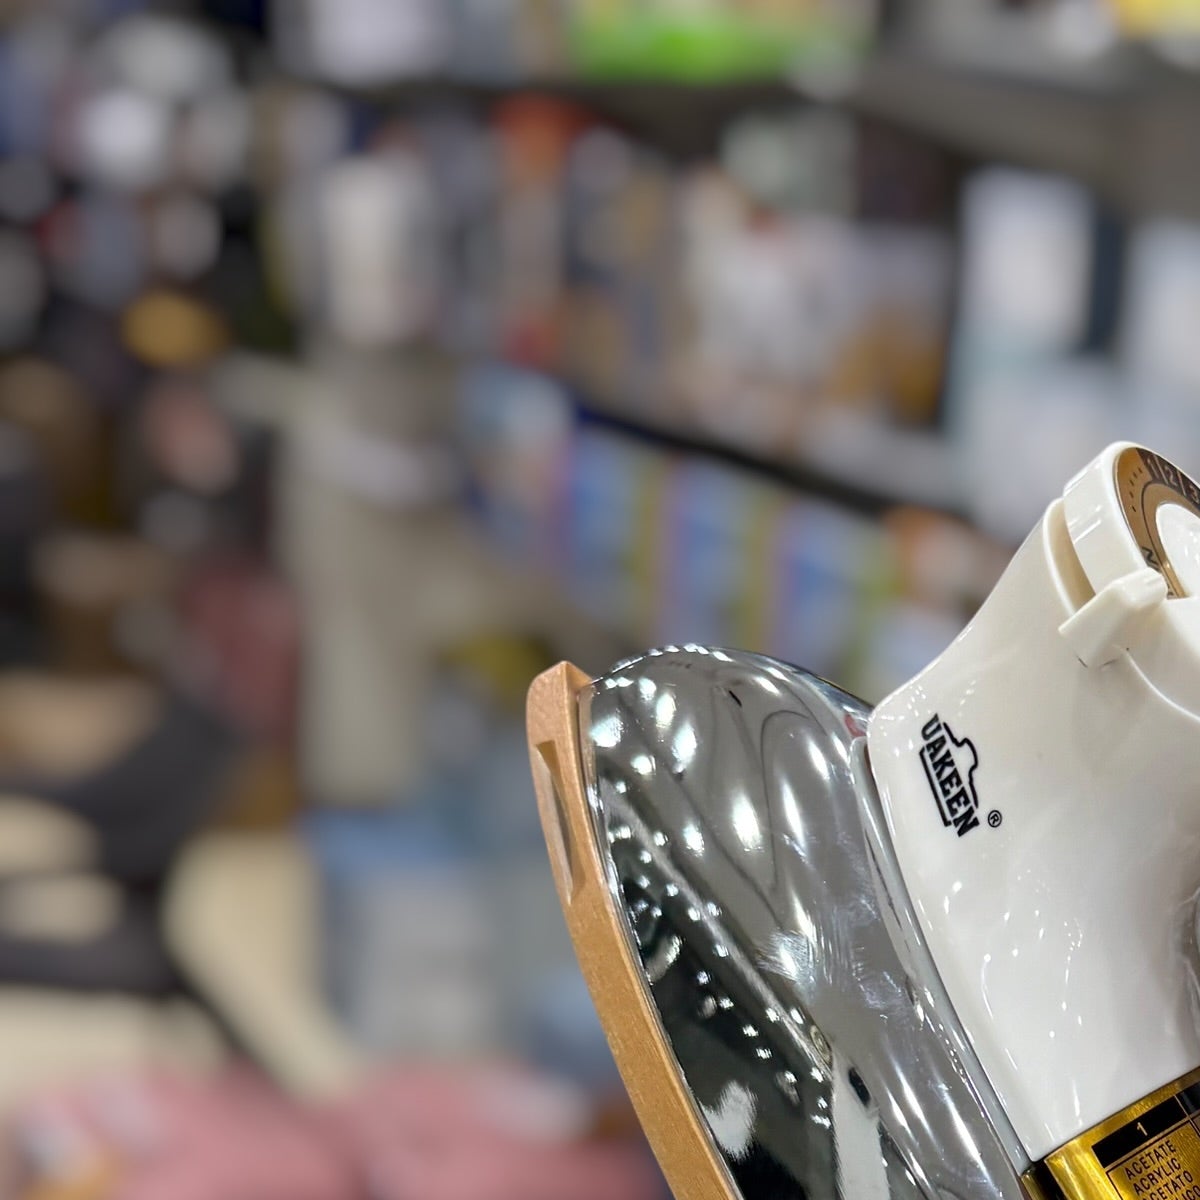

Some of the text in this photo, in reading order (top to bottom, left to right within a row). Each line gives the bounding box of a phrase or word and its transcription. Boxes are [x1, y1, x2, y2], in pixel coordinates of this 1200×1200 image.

[1164, 464, 1178, 487] 2
[1188, 484, 1200, 505] 3
[921, 713, 980, 837] UAKEEN
[1137, 1121, 1148, 1136] 1
[1124, 1139, 1176, 1180] ACETATE
[1132, 1158, 1181, 1196] ACRYLIC
